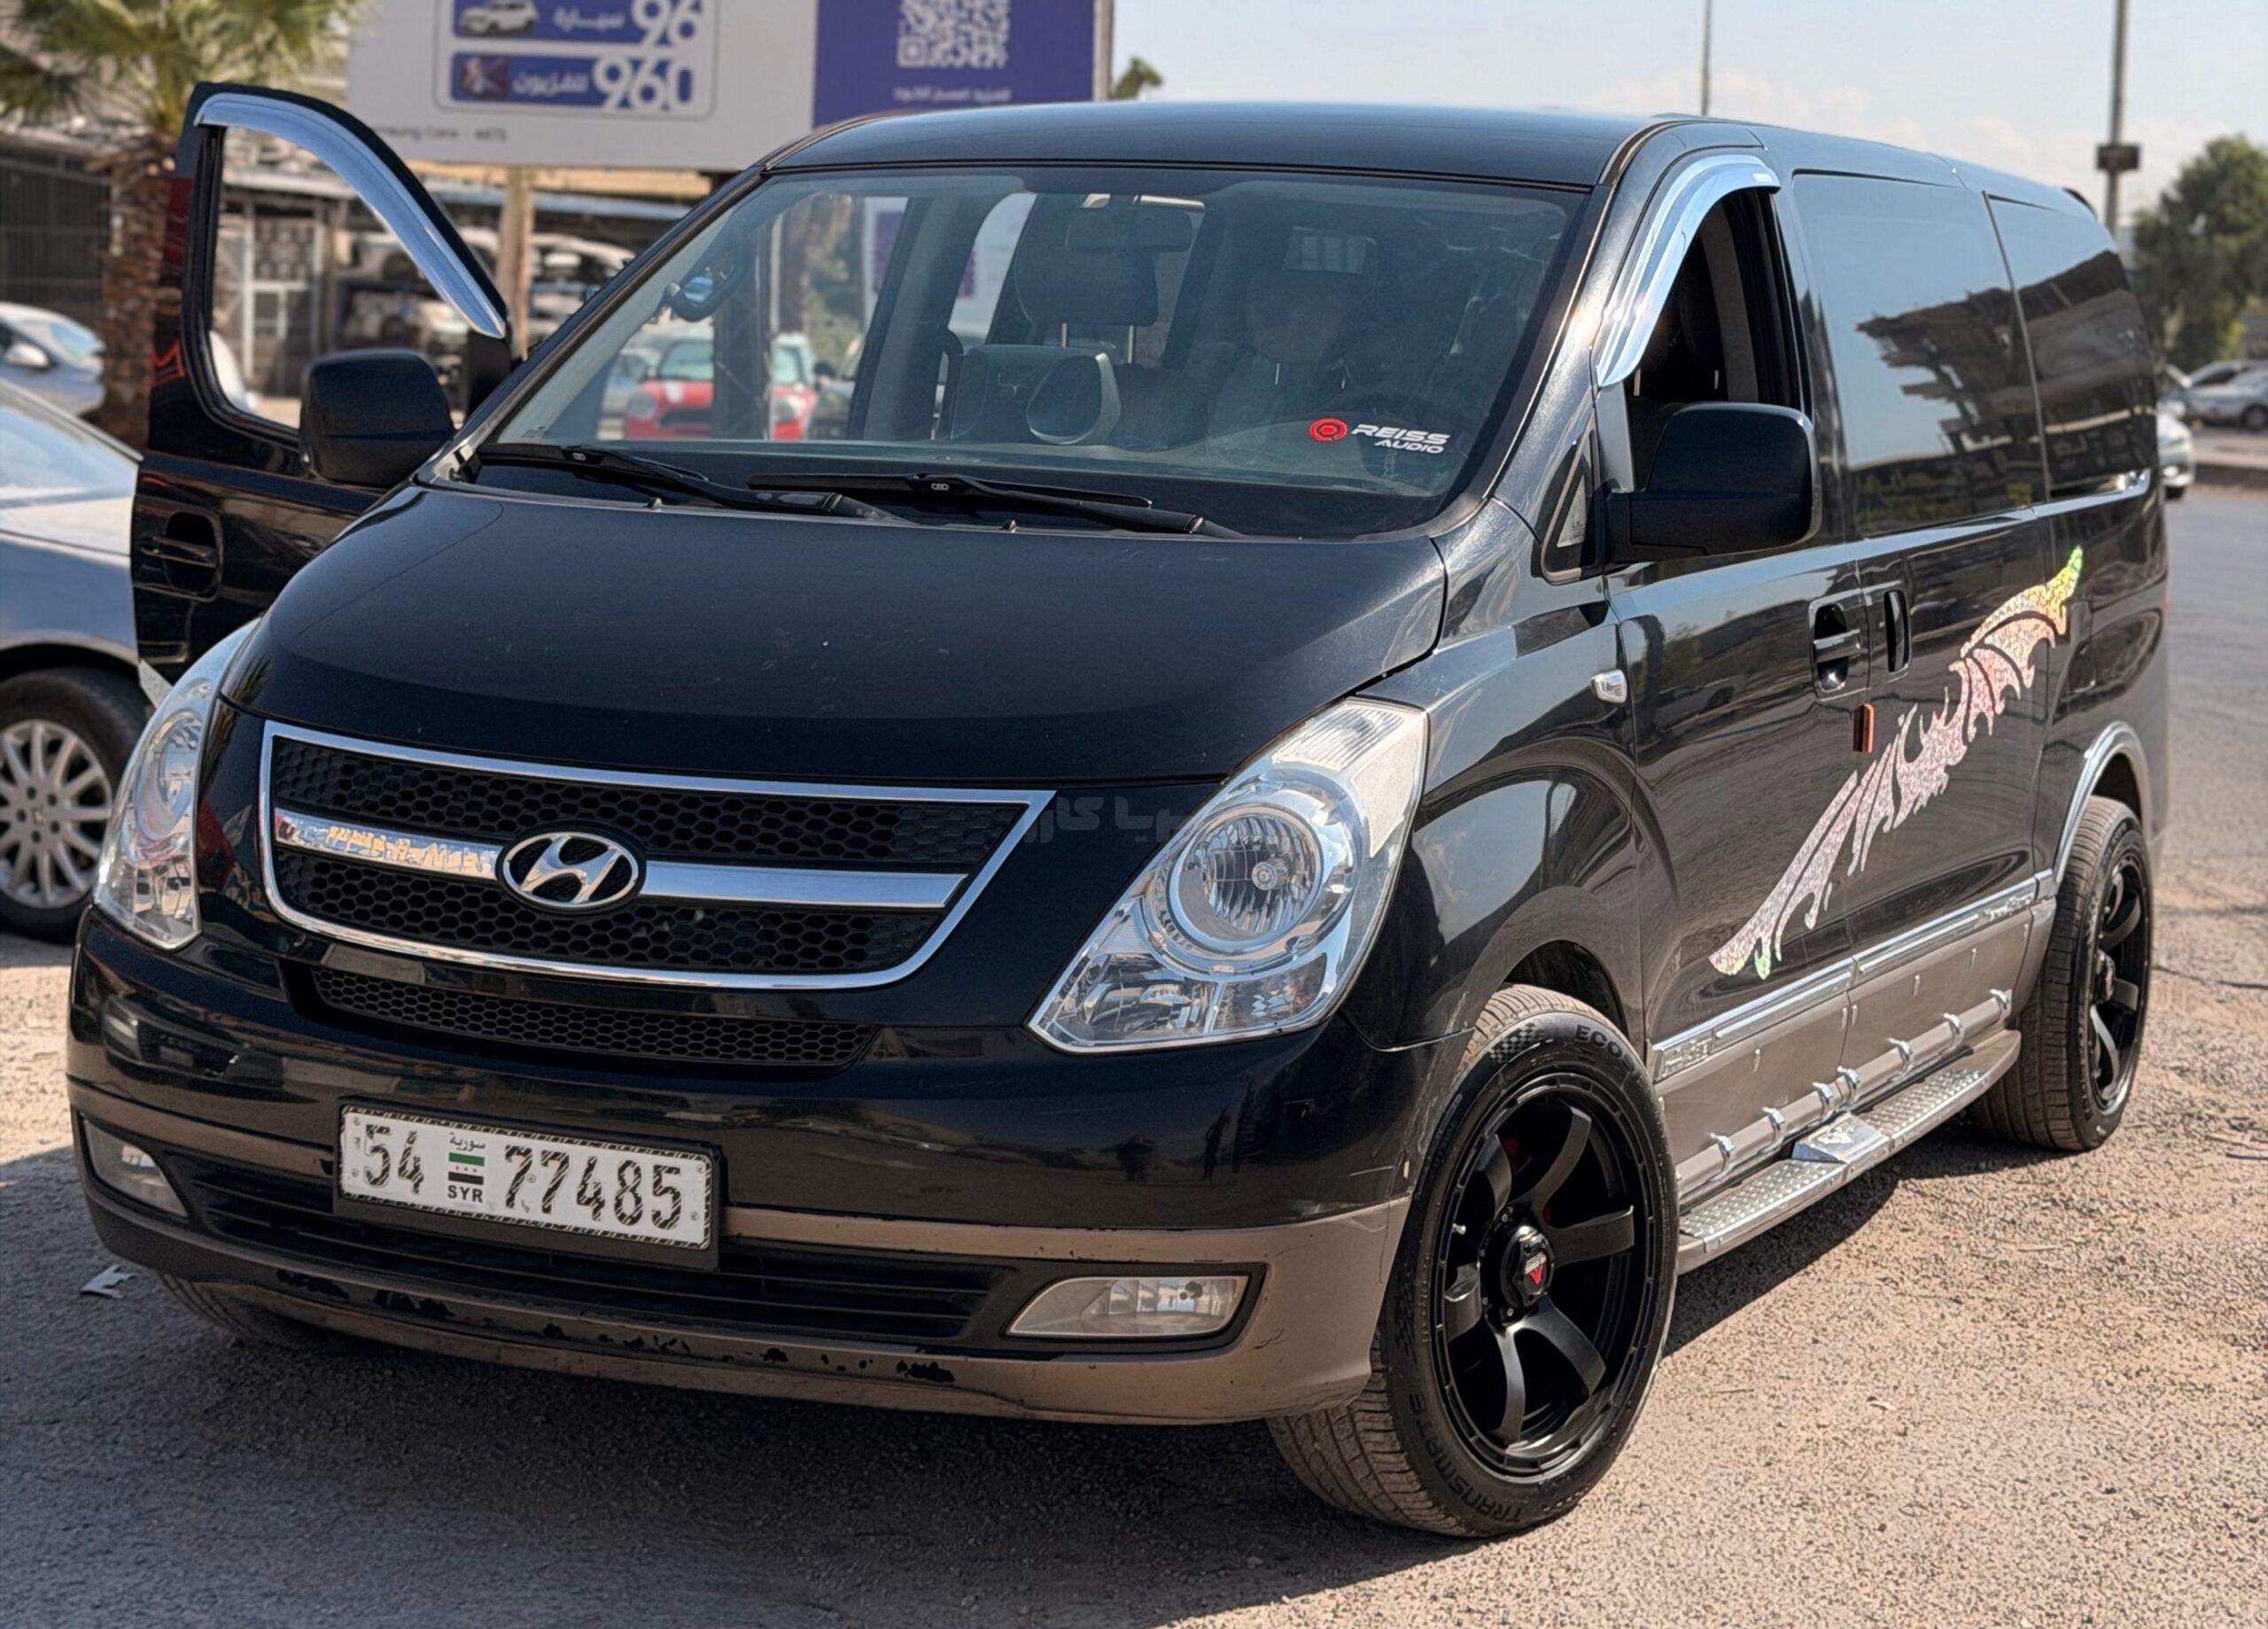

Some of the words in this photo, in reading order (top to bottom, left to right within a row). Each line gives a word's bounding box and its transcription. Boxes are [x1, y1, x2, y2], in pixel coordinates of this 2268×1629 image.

[1351, 423, 1451, 446] REISS
[1374, 438, 1445, 454] AUDIO
[448, 1131, 486, 1152] سورية
[363, 1123, 425, 1195] 54
[447, 1184, 484, 1204] SYR
[504, 1143, 682, 1230] 77485
